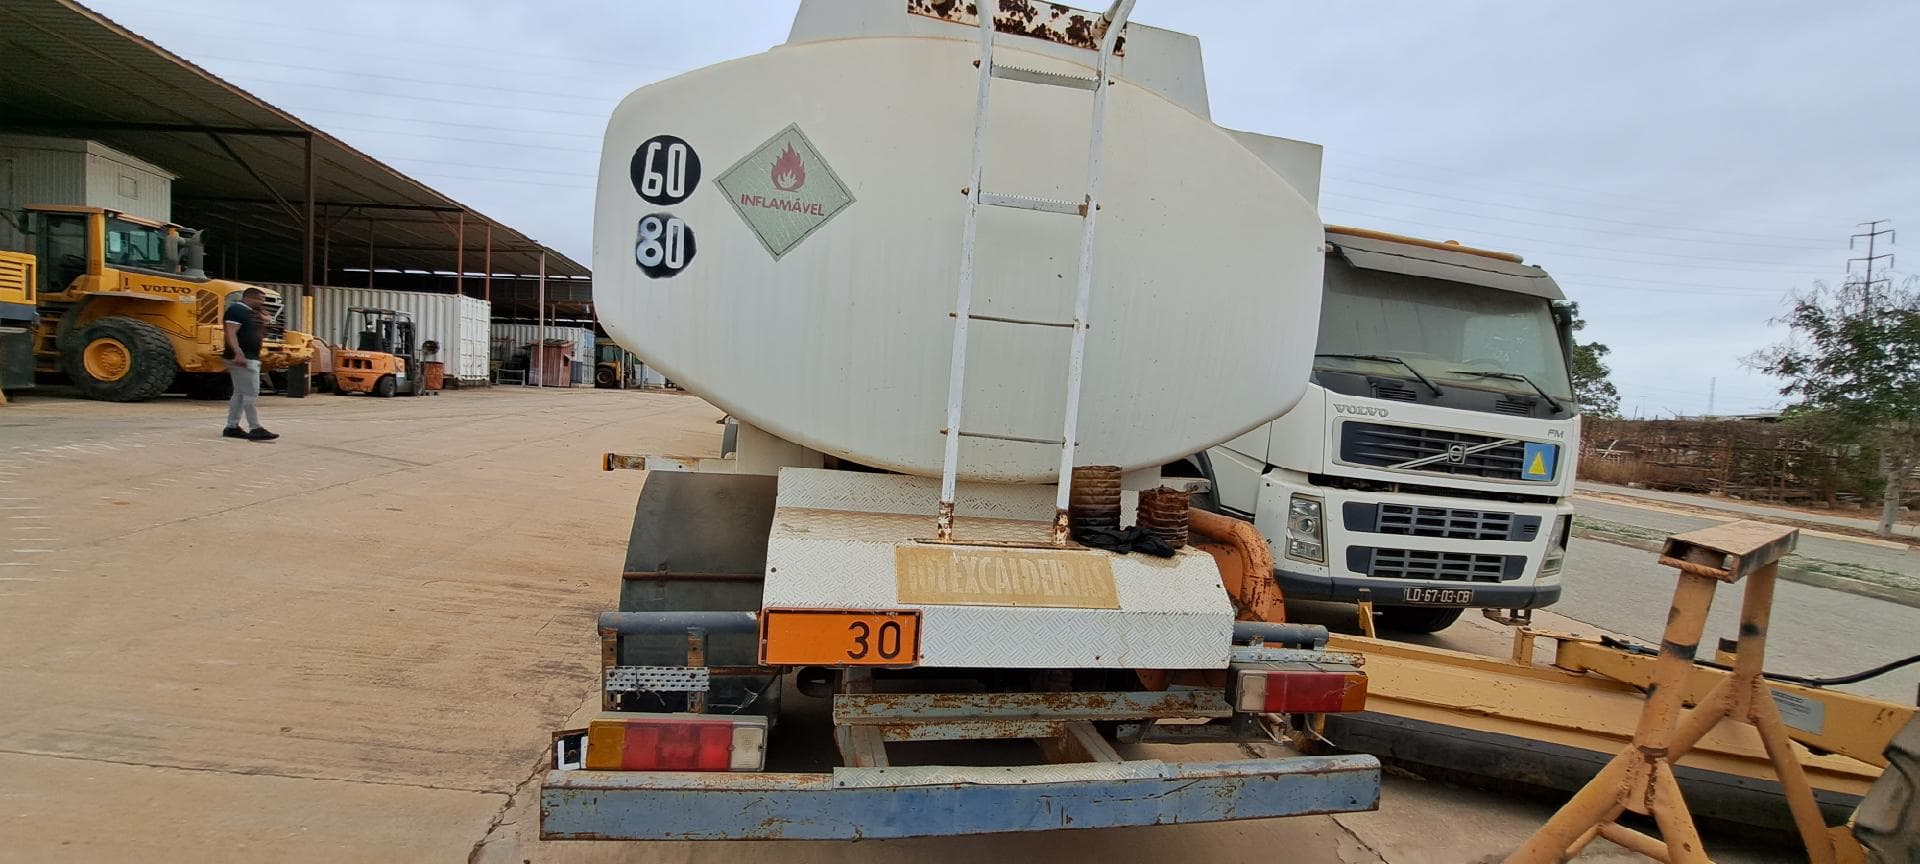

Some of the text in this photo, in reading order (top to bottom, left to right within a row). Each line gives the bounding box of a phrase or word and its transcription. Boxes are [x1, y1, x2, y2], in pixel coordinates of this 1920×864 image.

[641, 141, 687, 198] 60
[740, 193, 825, 217] INFLAMÁVEL
[636, 216, 685, 269] 80
[141, 284, 192, 295] VOLVO
[1333, 403, 1390, 418] VOLVO
[1547, 428, 1565, 439] FM
[846, 620, 901, 660] 30
